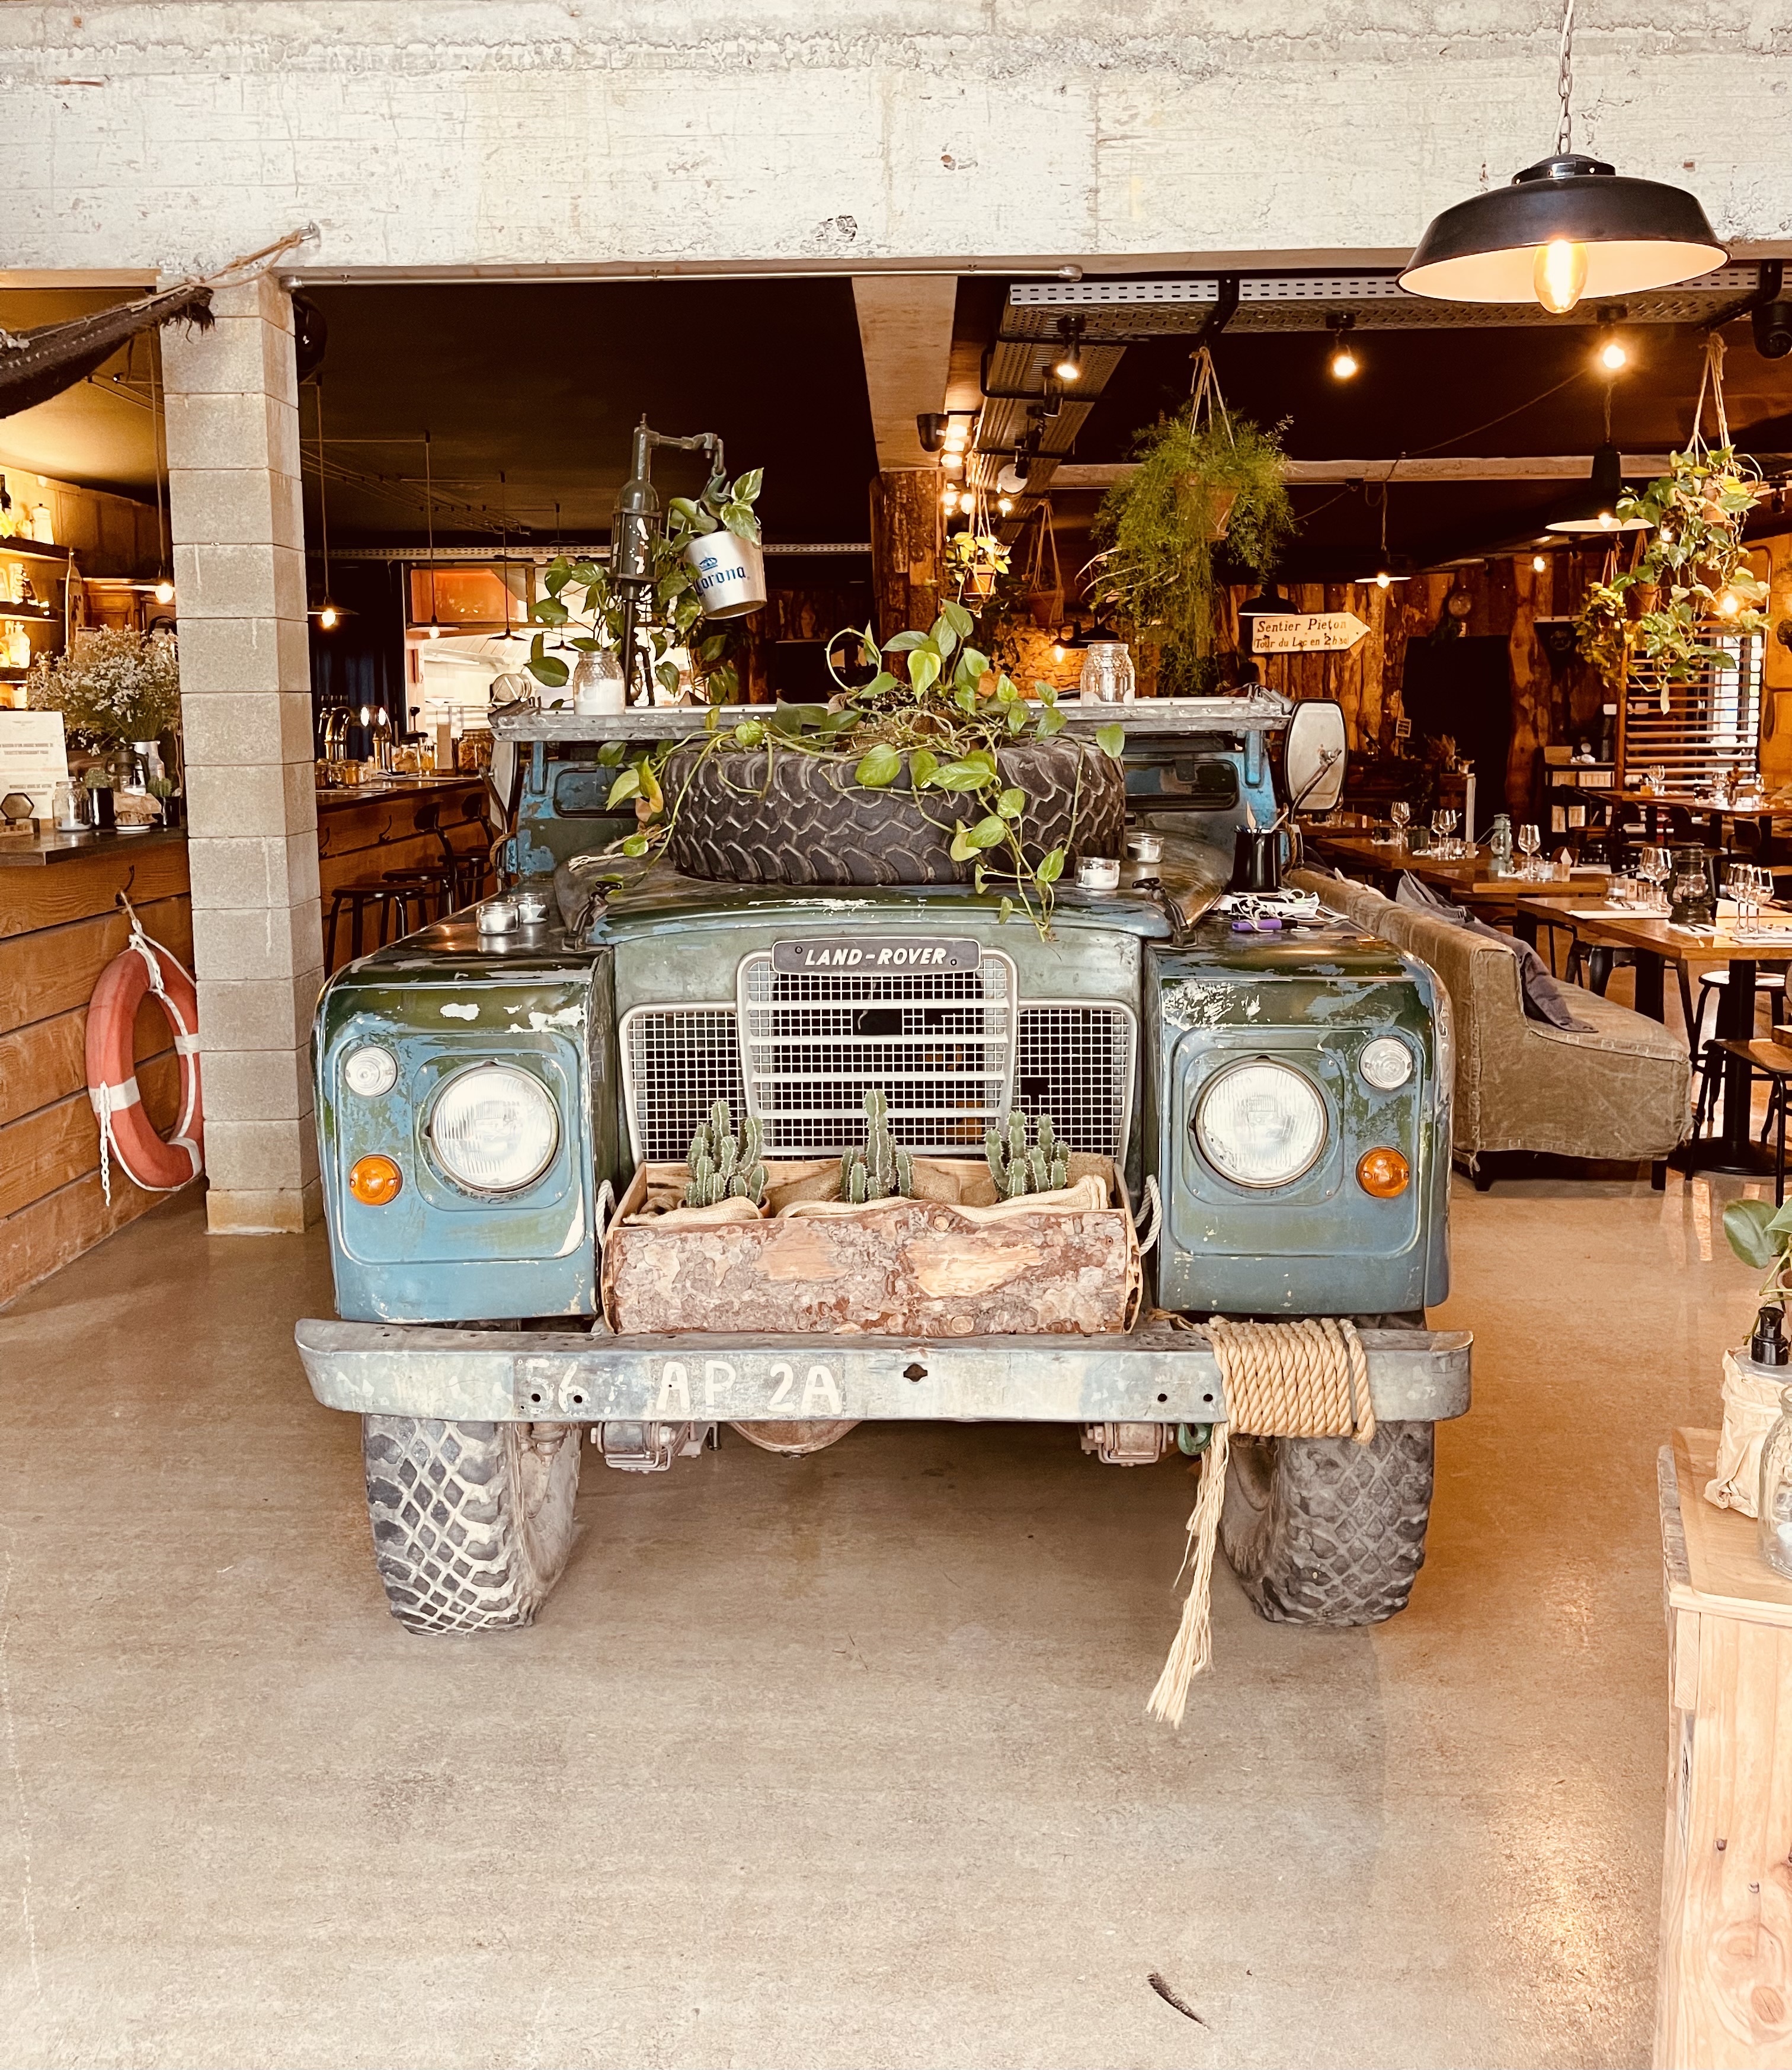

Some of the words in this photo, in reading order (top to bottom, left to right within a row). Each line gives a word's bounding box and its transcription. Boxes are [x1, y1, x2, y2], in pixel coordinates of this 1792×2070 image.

[1257, 621, 1301, 632] Sentier
[1307, 618, 1346, 630] Pieton
[1256, 635, 1275, 648] Tour
[1279, 638, 1288, 647] du
[804, 948, 947, 966] LAND-ROVER
[655, 1360, 737, 1414] AP
[767, 1362, 843, 1415] 2A
